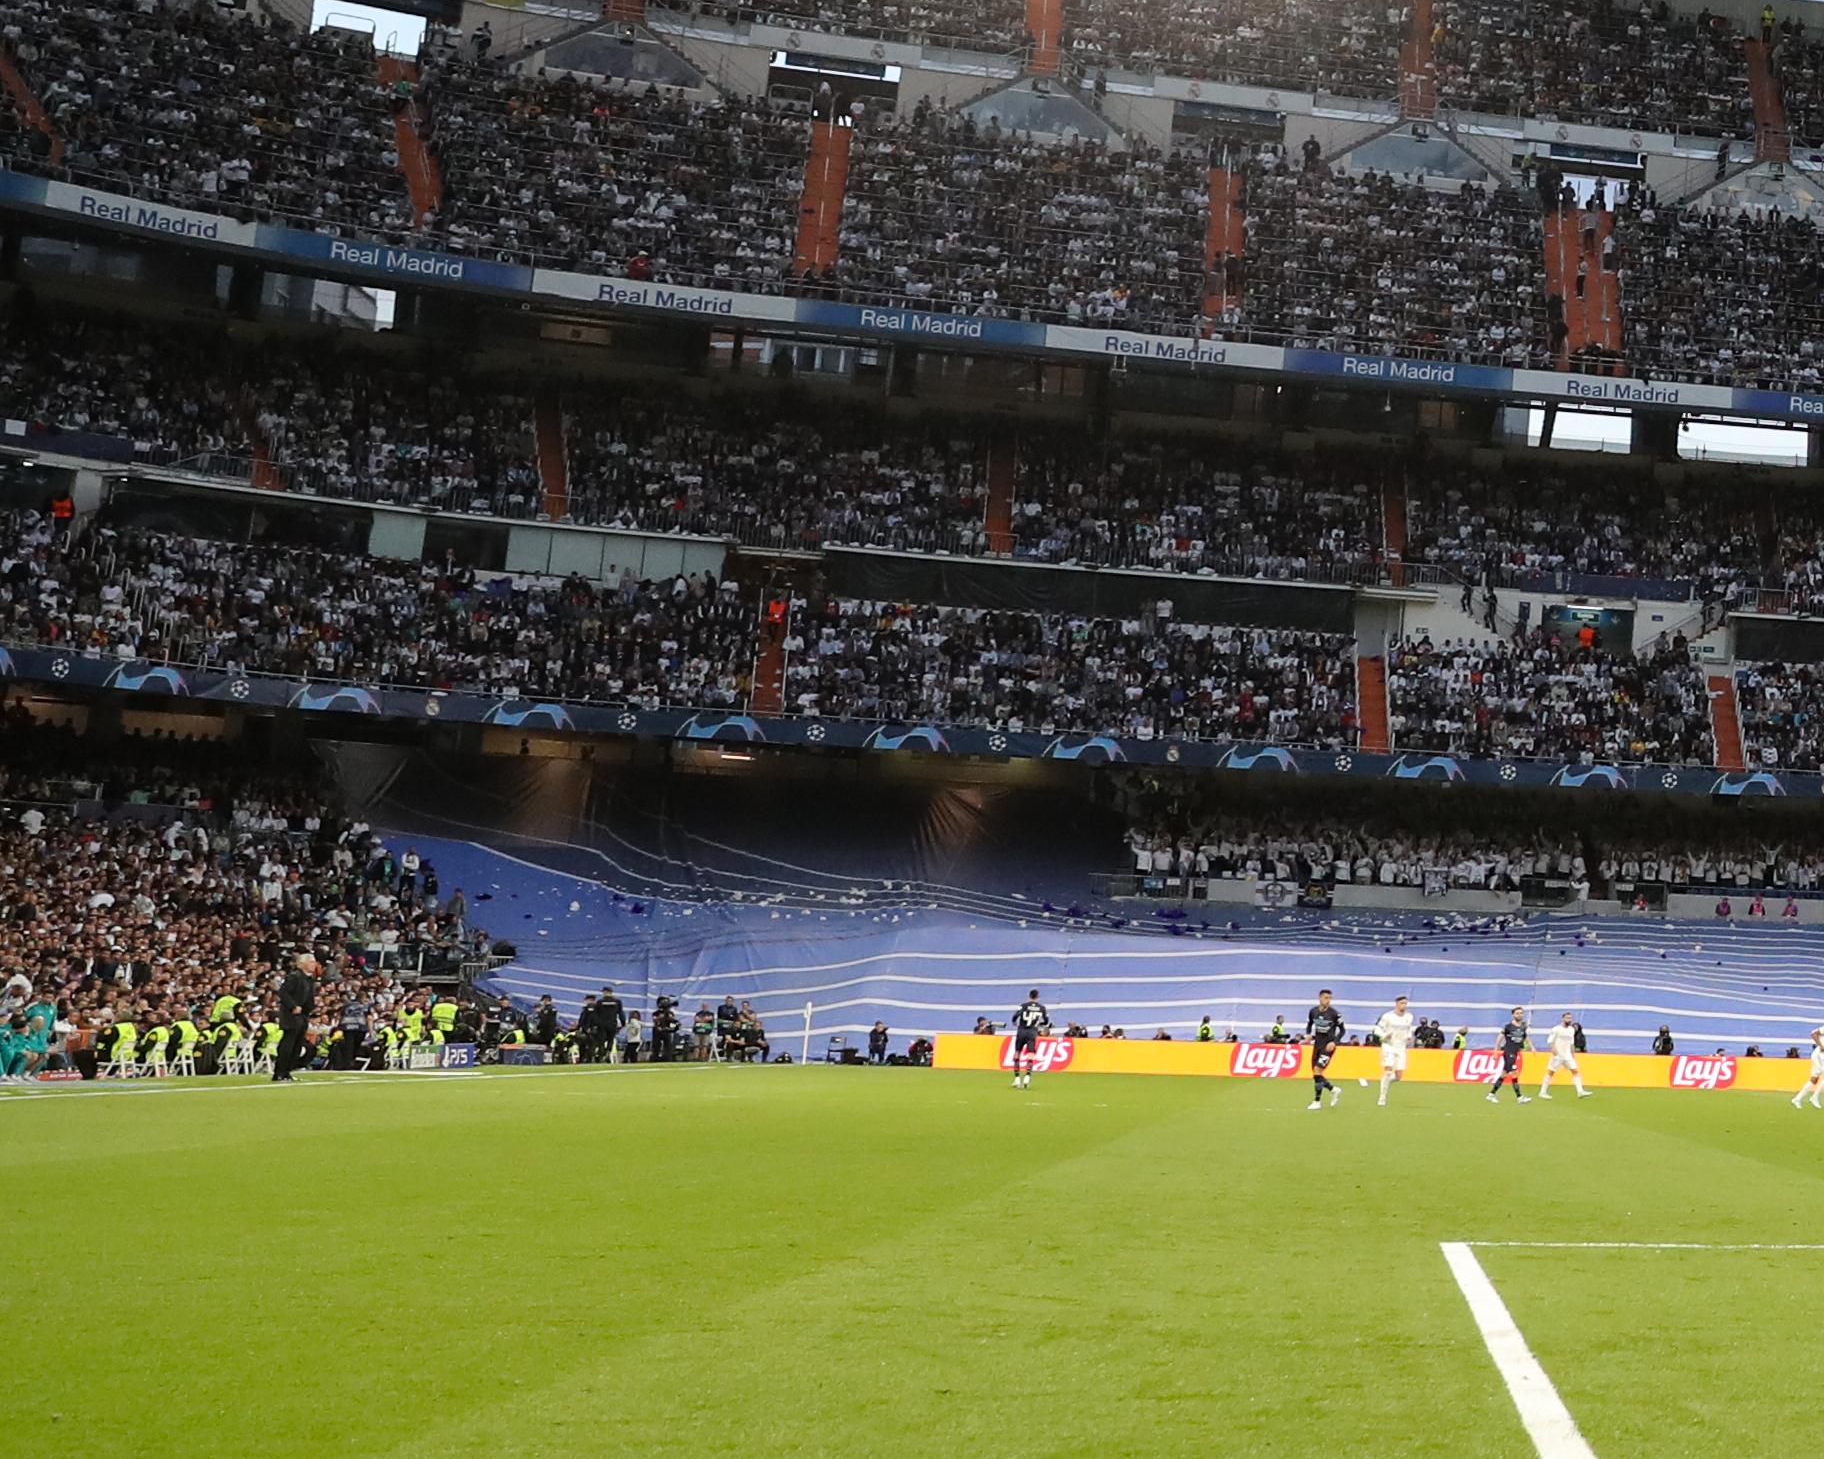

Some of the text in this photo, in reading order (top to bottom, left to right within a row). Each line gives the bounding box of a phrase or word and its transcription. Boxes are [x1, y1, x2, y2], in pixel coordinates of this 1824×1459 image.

[80, 196, 218, 240] Real Madrid
[331, 241, 463, 279] Real Madrid
[599, 284, 733, 313] Real Madrid
[861, 310, 982, 337] Real Madrid
[1105, 336, 1226, 363] Real Madrid
[1343, 358, 1455, 382] Real Madrid
[1567, 379, 1679, 403] Real Madrid
[1233, 1044, 1299, 1078] Lay's
[1673, 1055, 1734, 1089] Lay's
